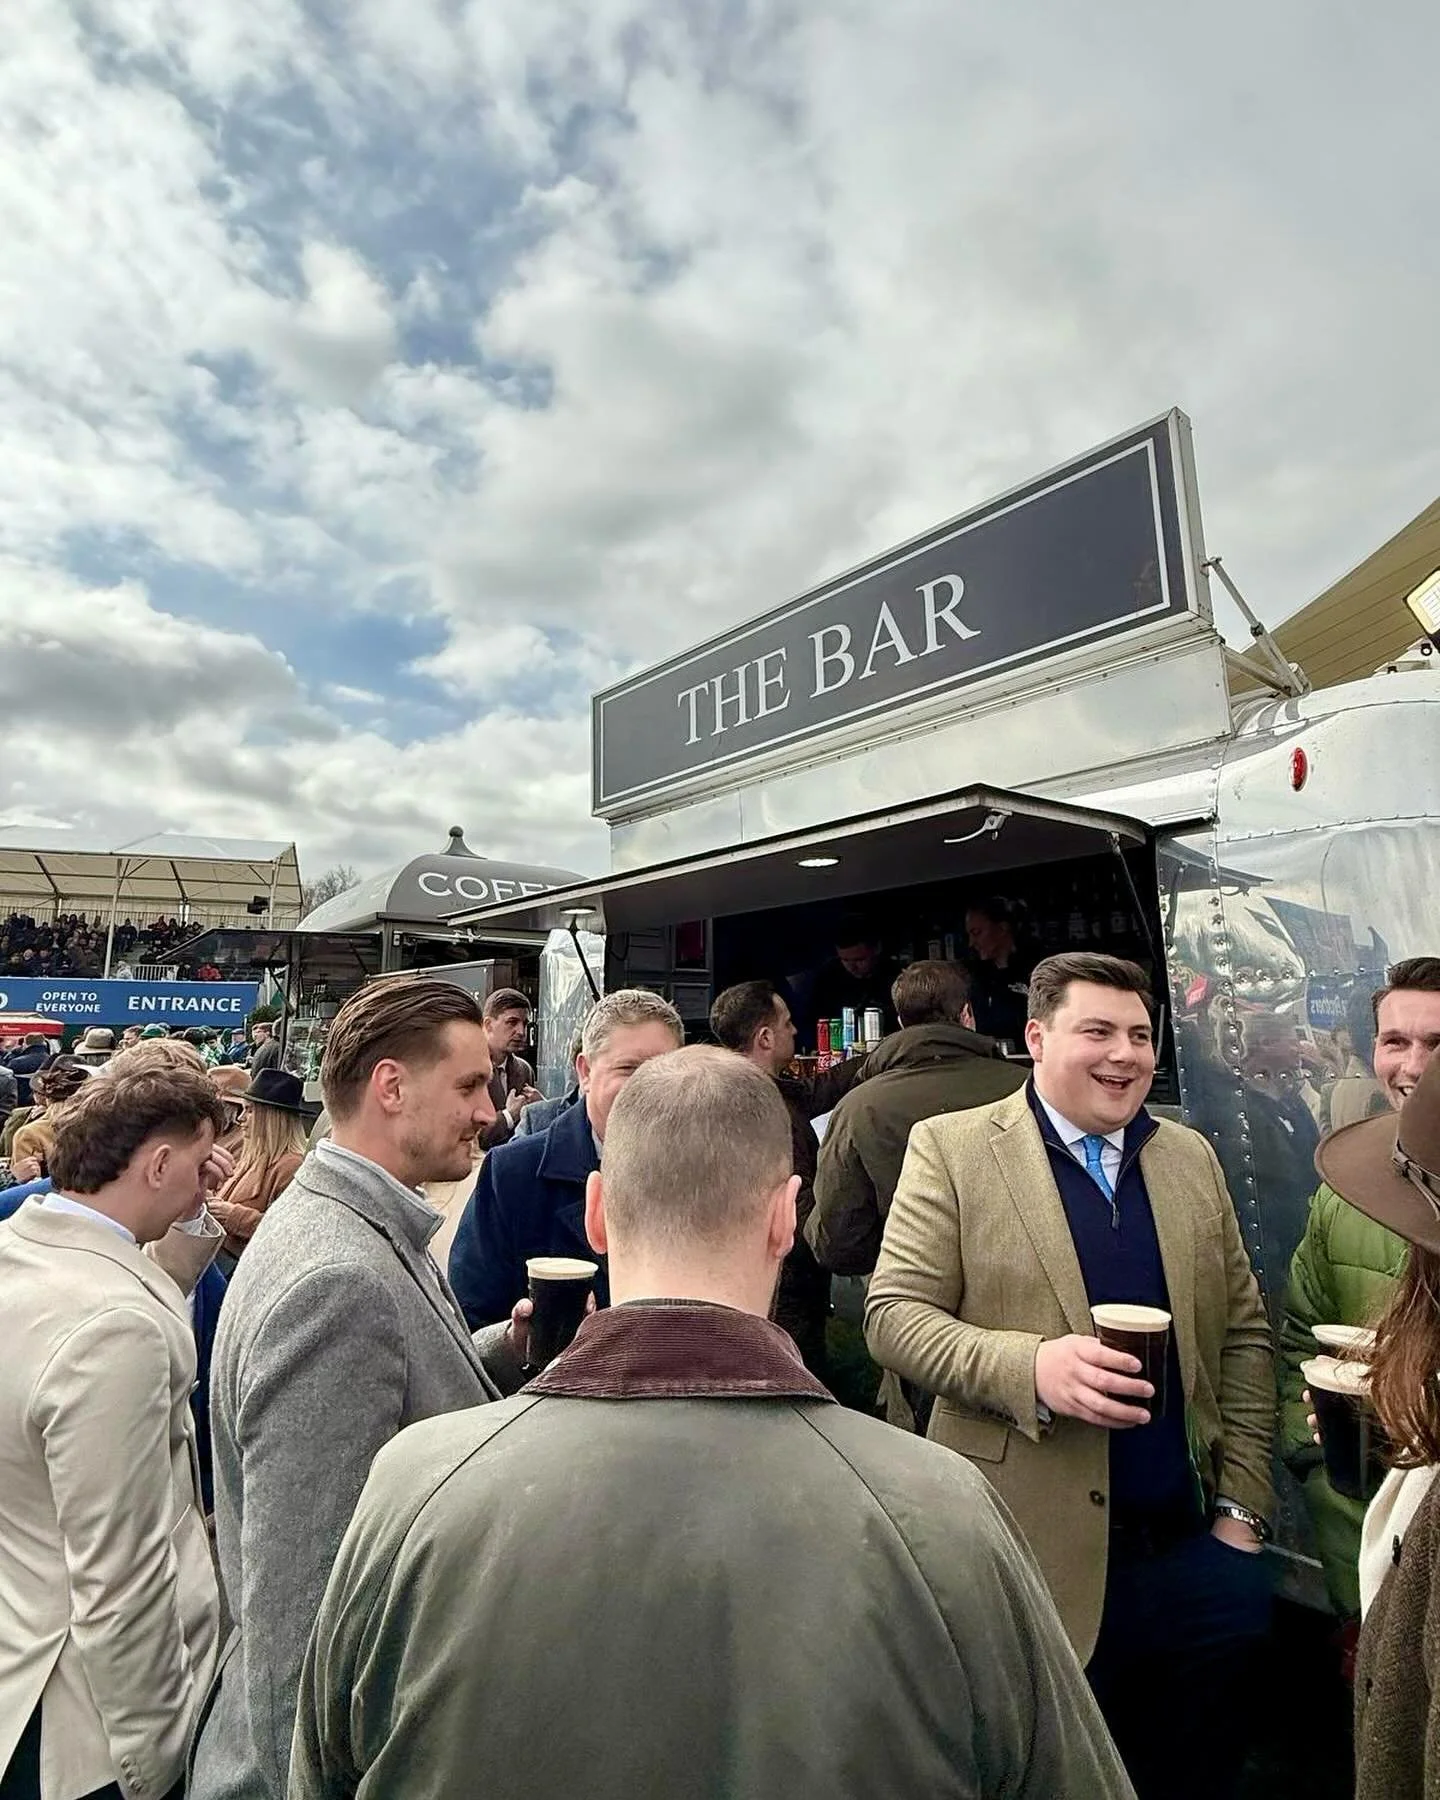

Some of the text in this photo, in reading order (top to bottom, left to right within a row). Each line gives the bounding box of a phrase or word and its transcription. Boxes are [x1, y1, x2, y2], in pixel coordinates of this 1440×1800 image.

[676, 573, 982, 747] THE BAR
[418, 872, 560, 901] COFF
[42, 991, 97, 1002] OPEN TO
[128, 996, 241, 1013] ENTRANCE
[35, 1003, 101, 1014] EVERYONE
